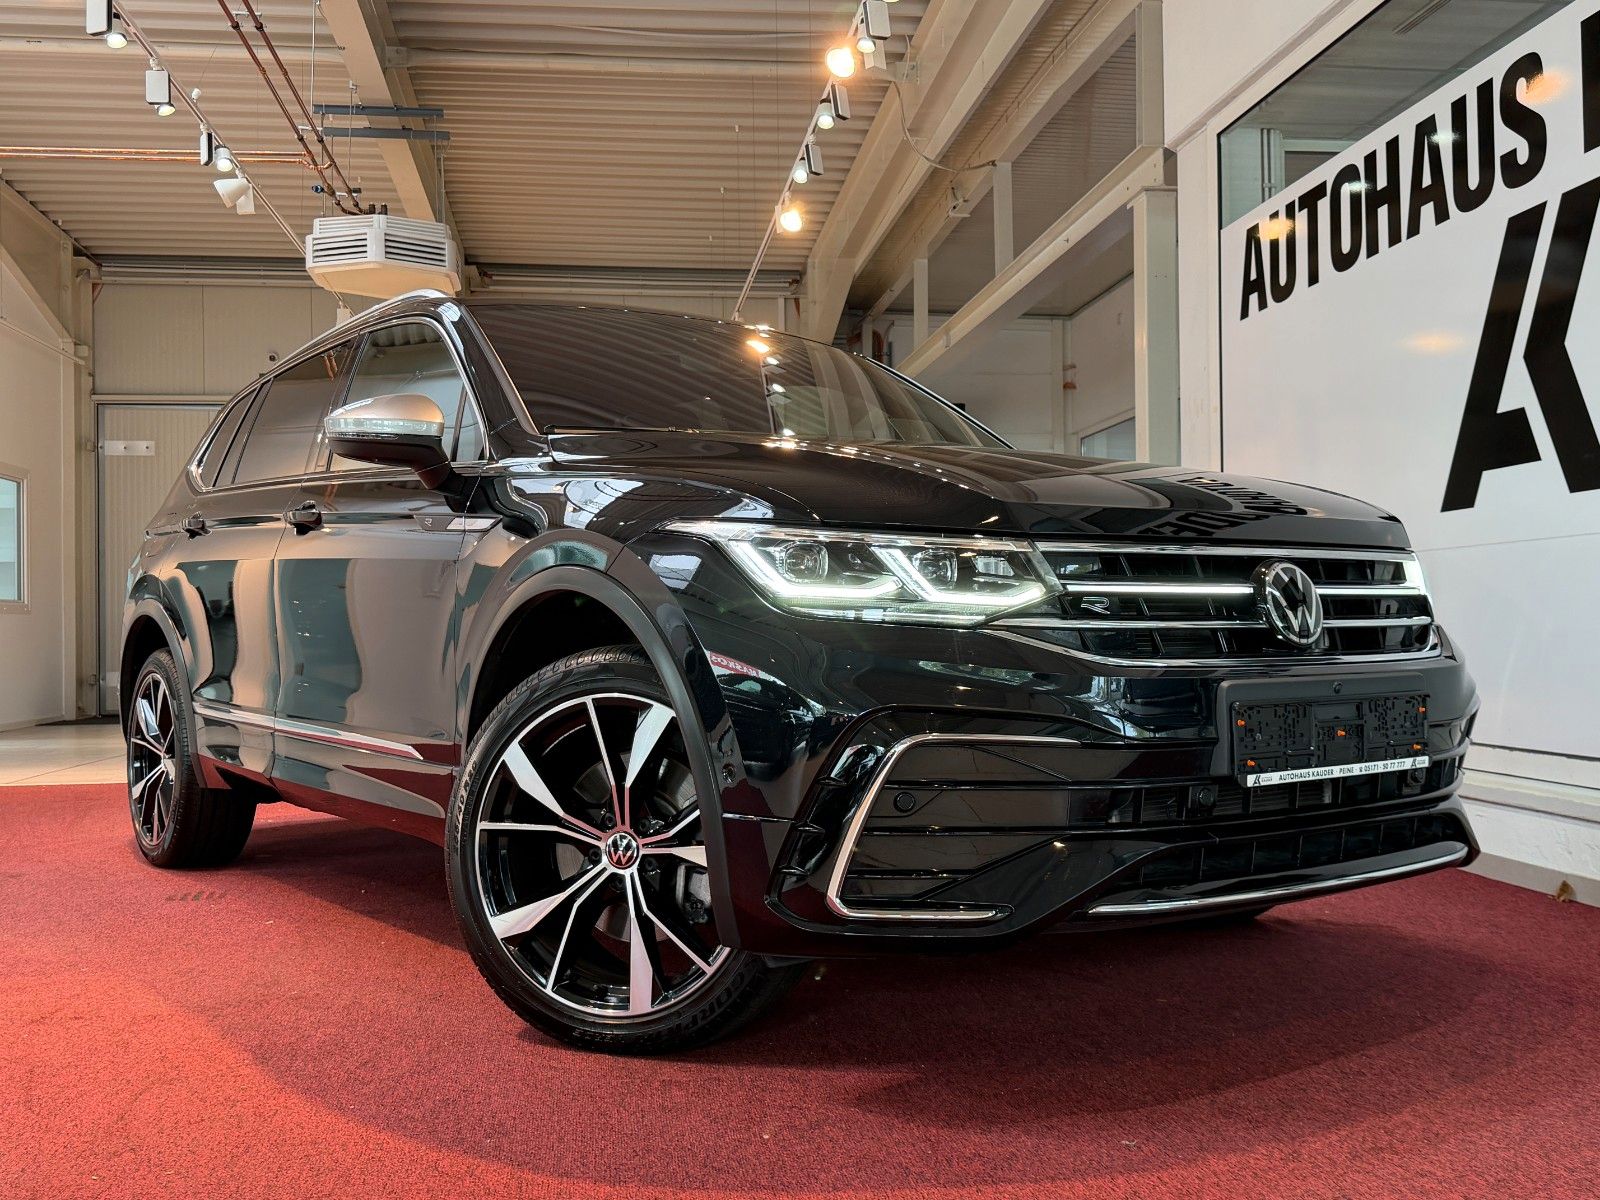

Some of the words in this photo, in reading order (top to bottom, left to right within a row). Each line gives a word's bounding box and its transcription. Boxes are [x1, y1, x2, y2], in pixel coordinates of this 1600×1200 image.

[1240, 52, 1547, 321] AUTOHAUS
[1279, 772, 1311, 781] AUTOHAUS
[1312, 768, 1334, 778] KAUDER
[1339, 766, 1354, 775] PEINE
